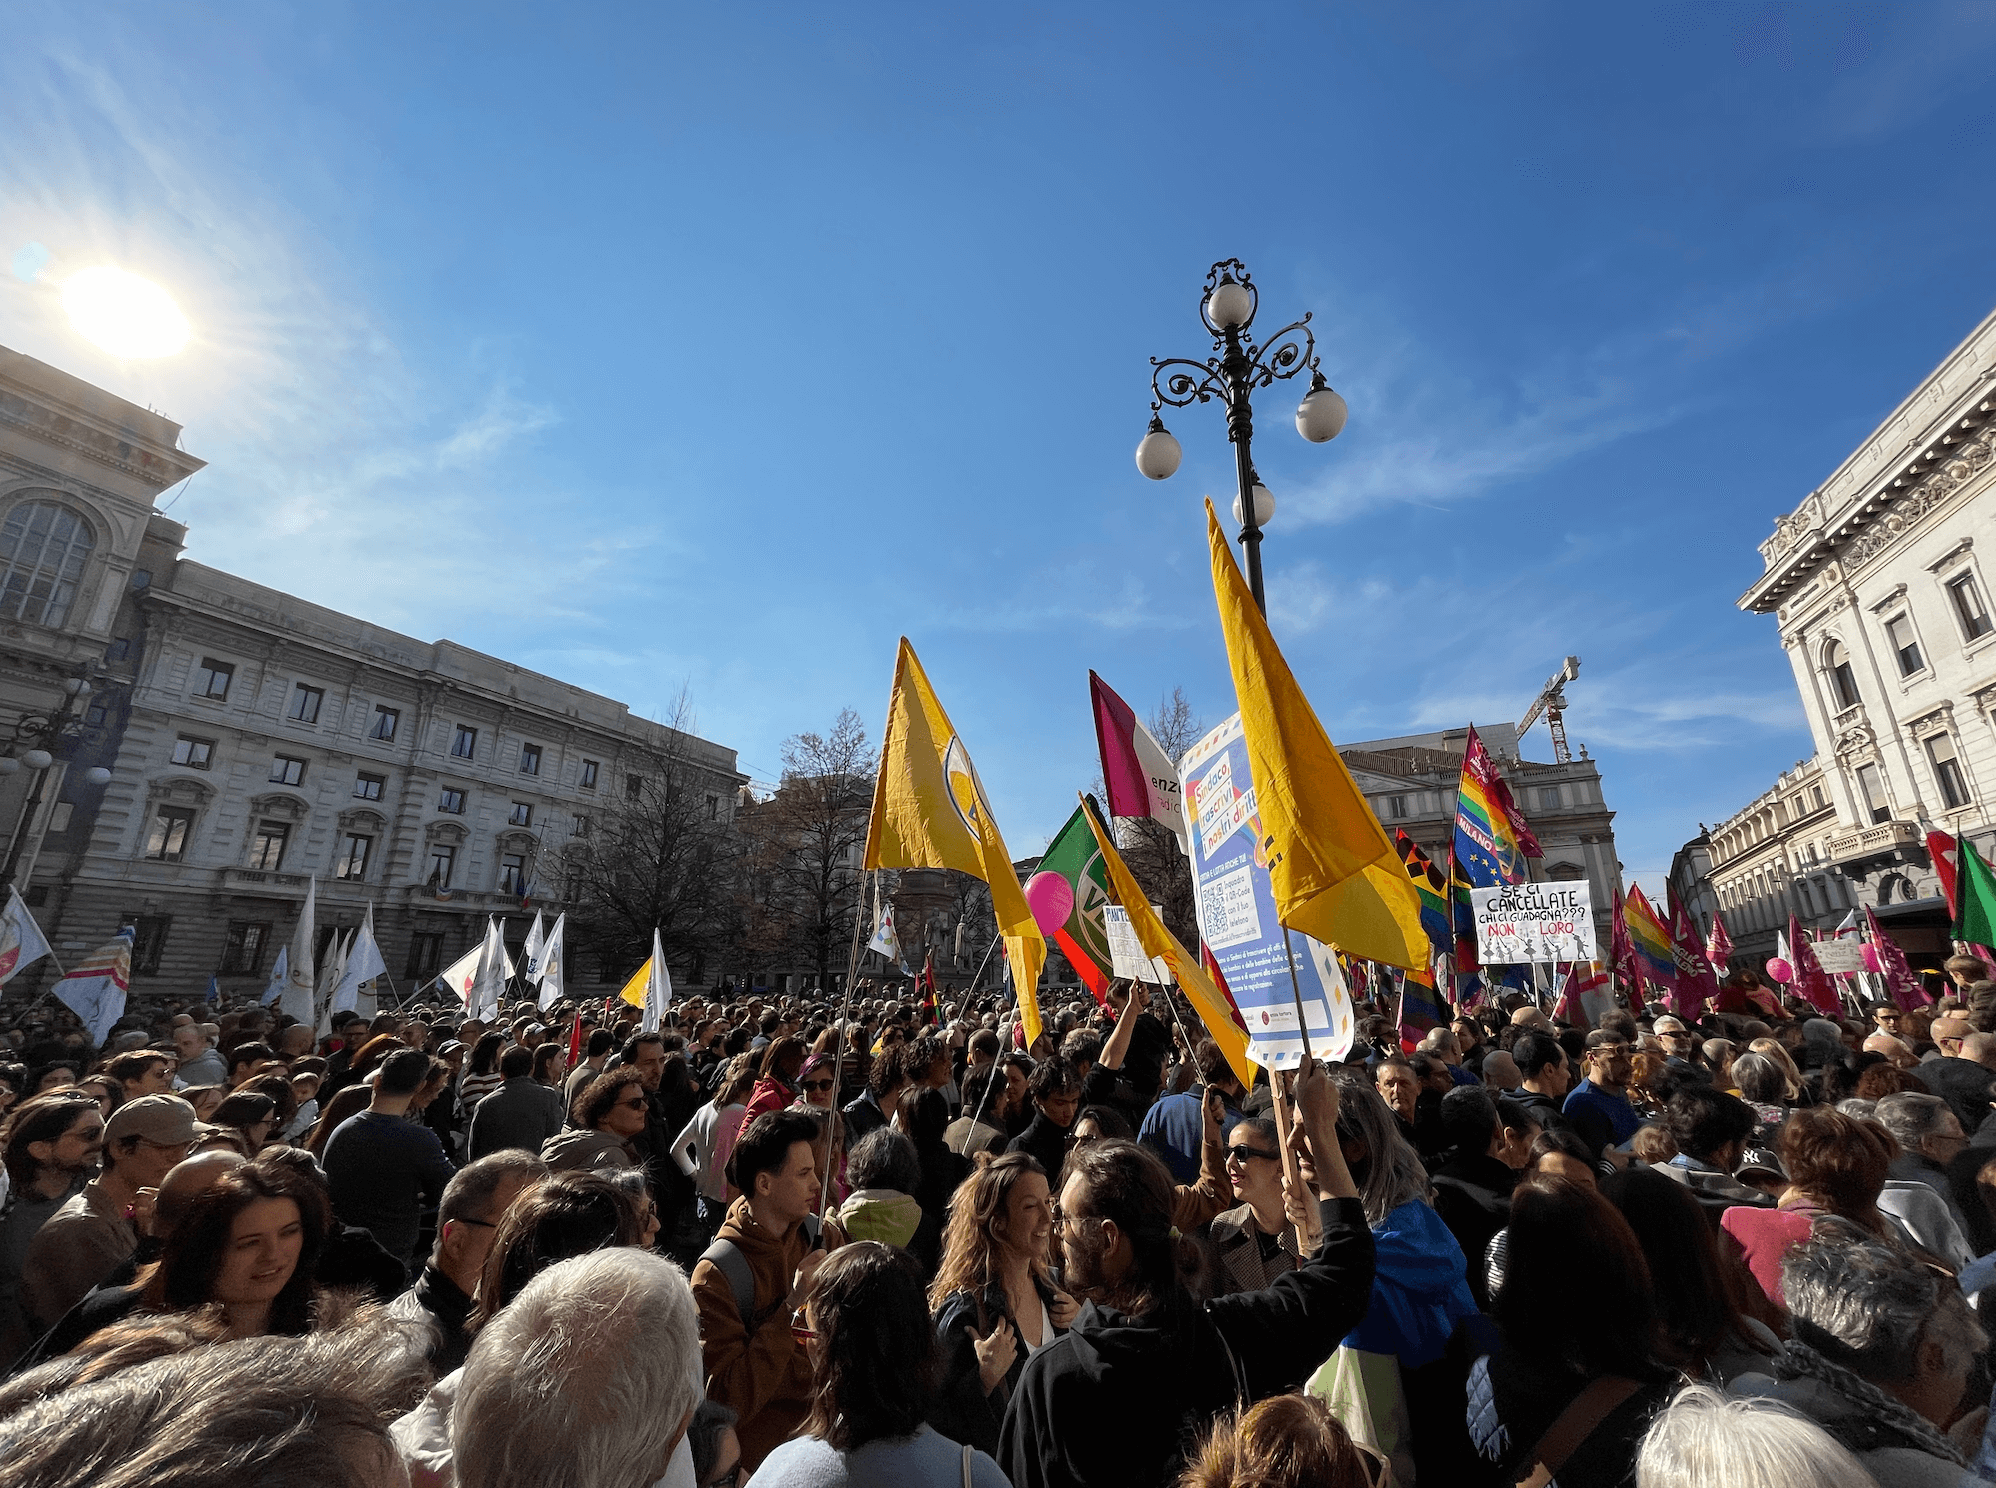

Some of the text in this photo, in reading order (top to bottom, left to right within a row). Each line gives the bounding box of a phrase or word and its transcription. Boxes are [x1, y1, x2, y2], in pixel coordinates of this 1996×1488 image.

[1195, 763, 1230, 804] Sindaco,
[1199, 781, 1233, 829] trascrivi
[1202, 788, 1257, 855] i nostri diritt
[1458, 817, 1493, 851] MILANO
[1486, 890, 1578, 912] CANCELLATE
[1500, 884, 1540, 898] SE CI
[1479, 906, 1586, 924] CHI CI GUADAGNA???
[1488, 921, 1574, 937] NON LORO
[1742, 1149, 1761, 1164] NY
